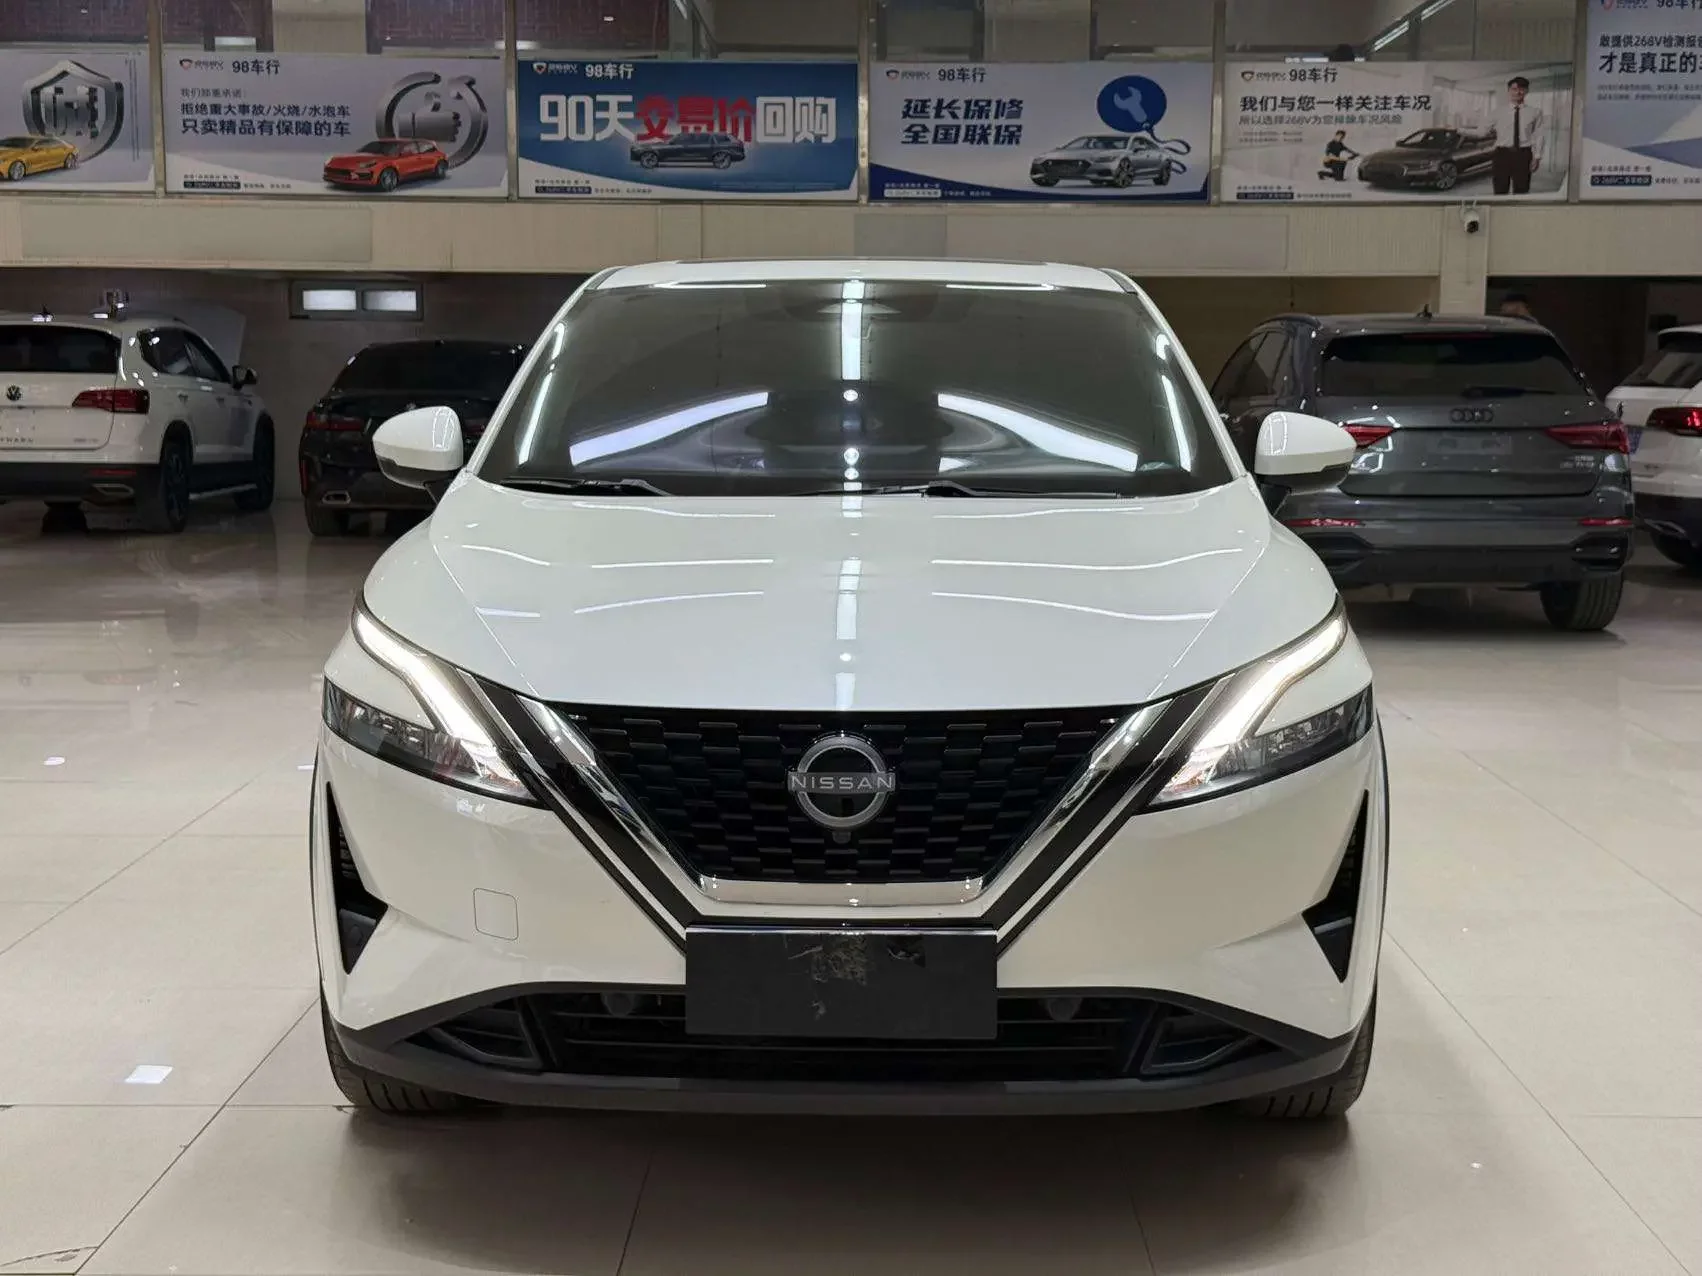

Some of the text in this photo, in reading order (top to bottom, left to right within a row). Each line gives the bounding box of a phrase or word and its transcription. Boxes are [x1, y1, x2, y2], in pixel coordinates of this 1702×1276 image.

[232, 59, 280, 75] 98车行
[585, 62, 635, 80] 98车行
[1599, 51, 1702, 74] 才是真正的
[937, 67, 987, 83] 98车行
[1288, 67, 1338, 83] 98车行
[180, 102, 351, 117] 拒绝重大事故/火烧/水泡车
[901, 97, 1024, 121] 延长保修
[1240, 95, 1432, 112] 我们与您一样关注车况
[539, 92, 837, 144] 90天交易价回购
[181, 118, 351, 137] 只卖精品有保障的车
[901, 123, 1024, 146] 全国联保
[791, 776, 892, 790] NISSAN
